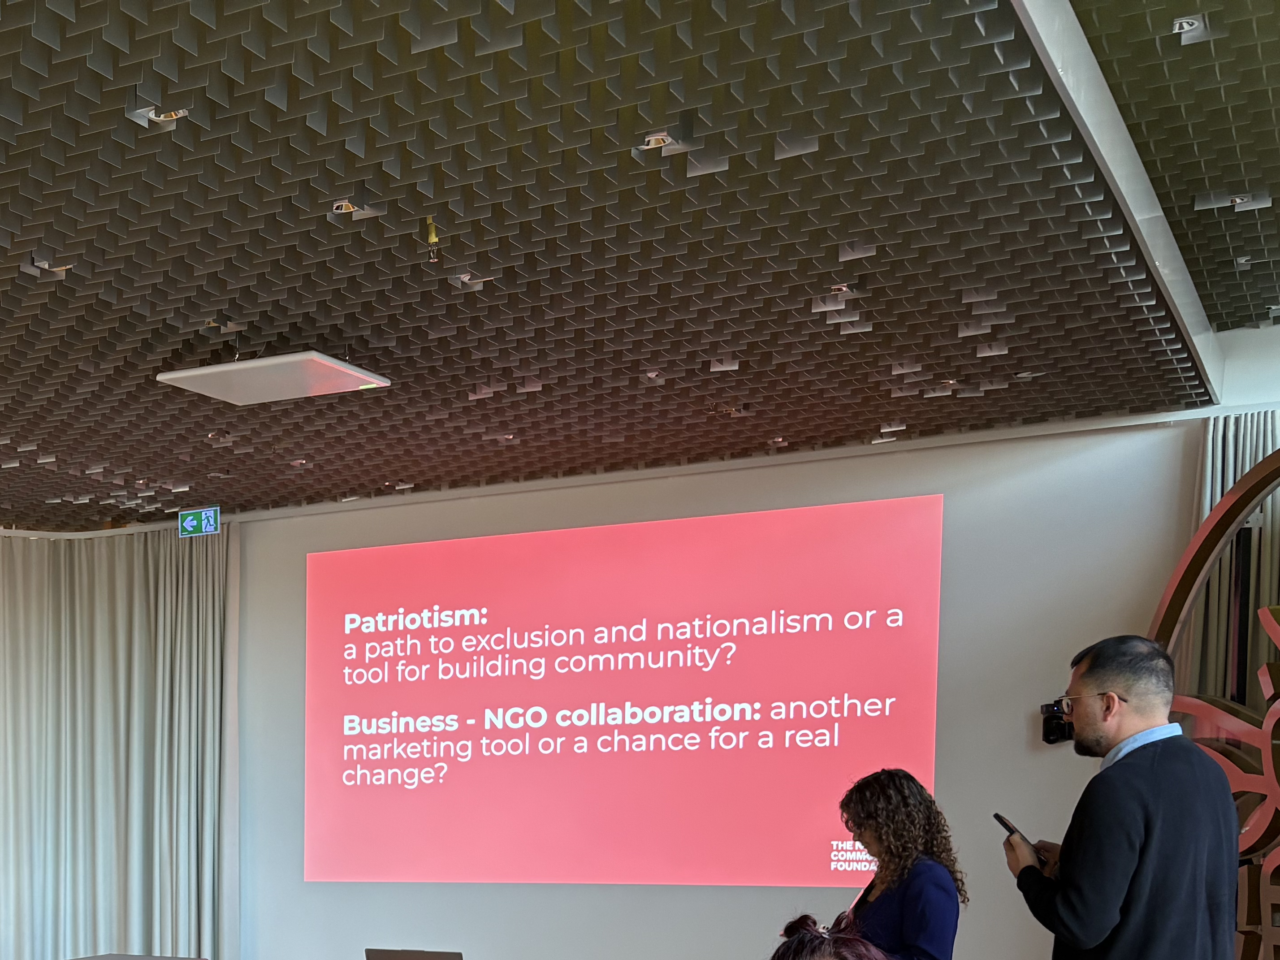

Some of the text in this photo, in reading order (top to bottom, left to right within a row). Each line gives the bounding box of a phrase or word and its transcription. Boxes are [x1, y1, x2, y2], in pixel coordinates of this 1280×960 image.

[344, 605, 488, 634] Patriotism:
[344, 608, 903, 663] a path to exclusion and nationalism or a
[343, 642, 736, 685] tool for building community?
[343, 711, 459, 735] Business
[484, 706, 548, 730] NGO
[555, 697, 762, 727] collaboration:
[770, 693, 896, 720] another
[343, 722, 839, 762] marketing tool or a chance for a real
[342, 762, 448, 790] change?
[831, 841, 853, 850] THE
